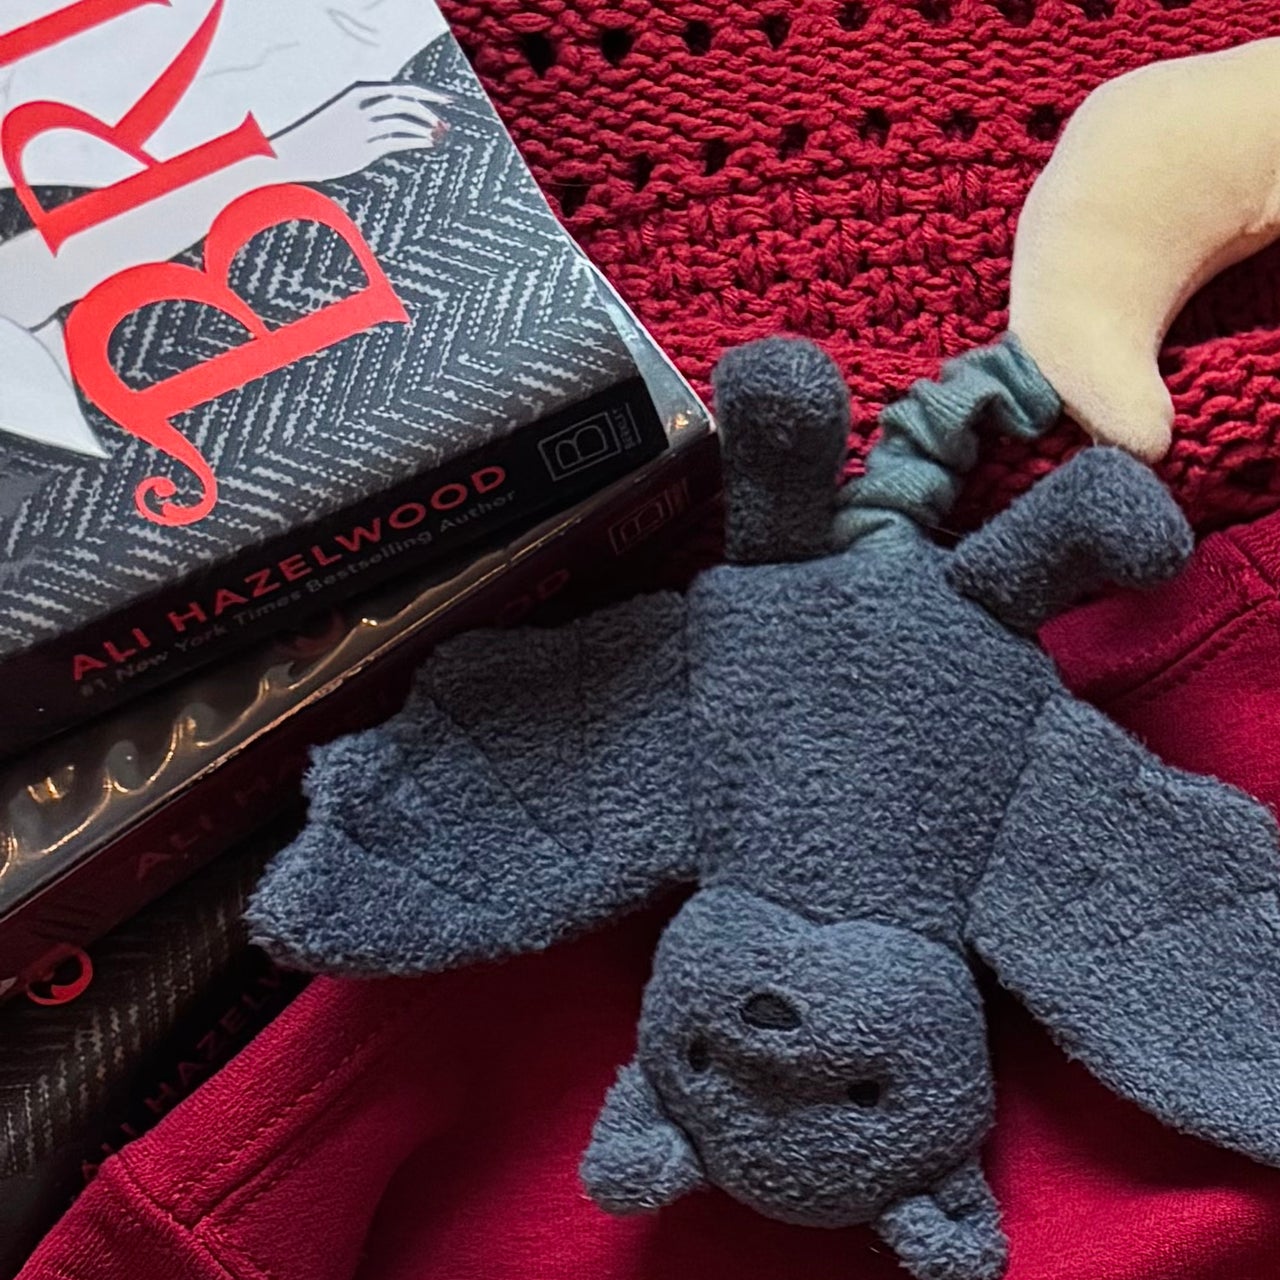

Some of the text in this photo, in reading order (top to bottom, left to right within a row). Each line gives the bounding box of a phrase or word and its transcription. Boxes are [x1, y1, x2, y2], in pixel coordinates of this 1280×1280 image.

[72, 626, 153, 682] ALI
[168, 465, 507, 632] HAZELWOOD
[115, 649, 169, 682] New
[175, 621, 228, 654] York
[234, 588, 301, 628] Times
[306, 528, 432, 594] Bestselling
[440, 489, 518, 534] Author
